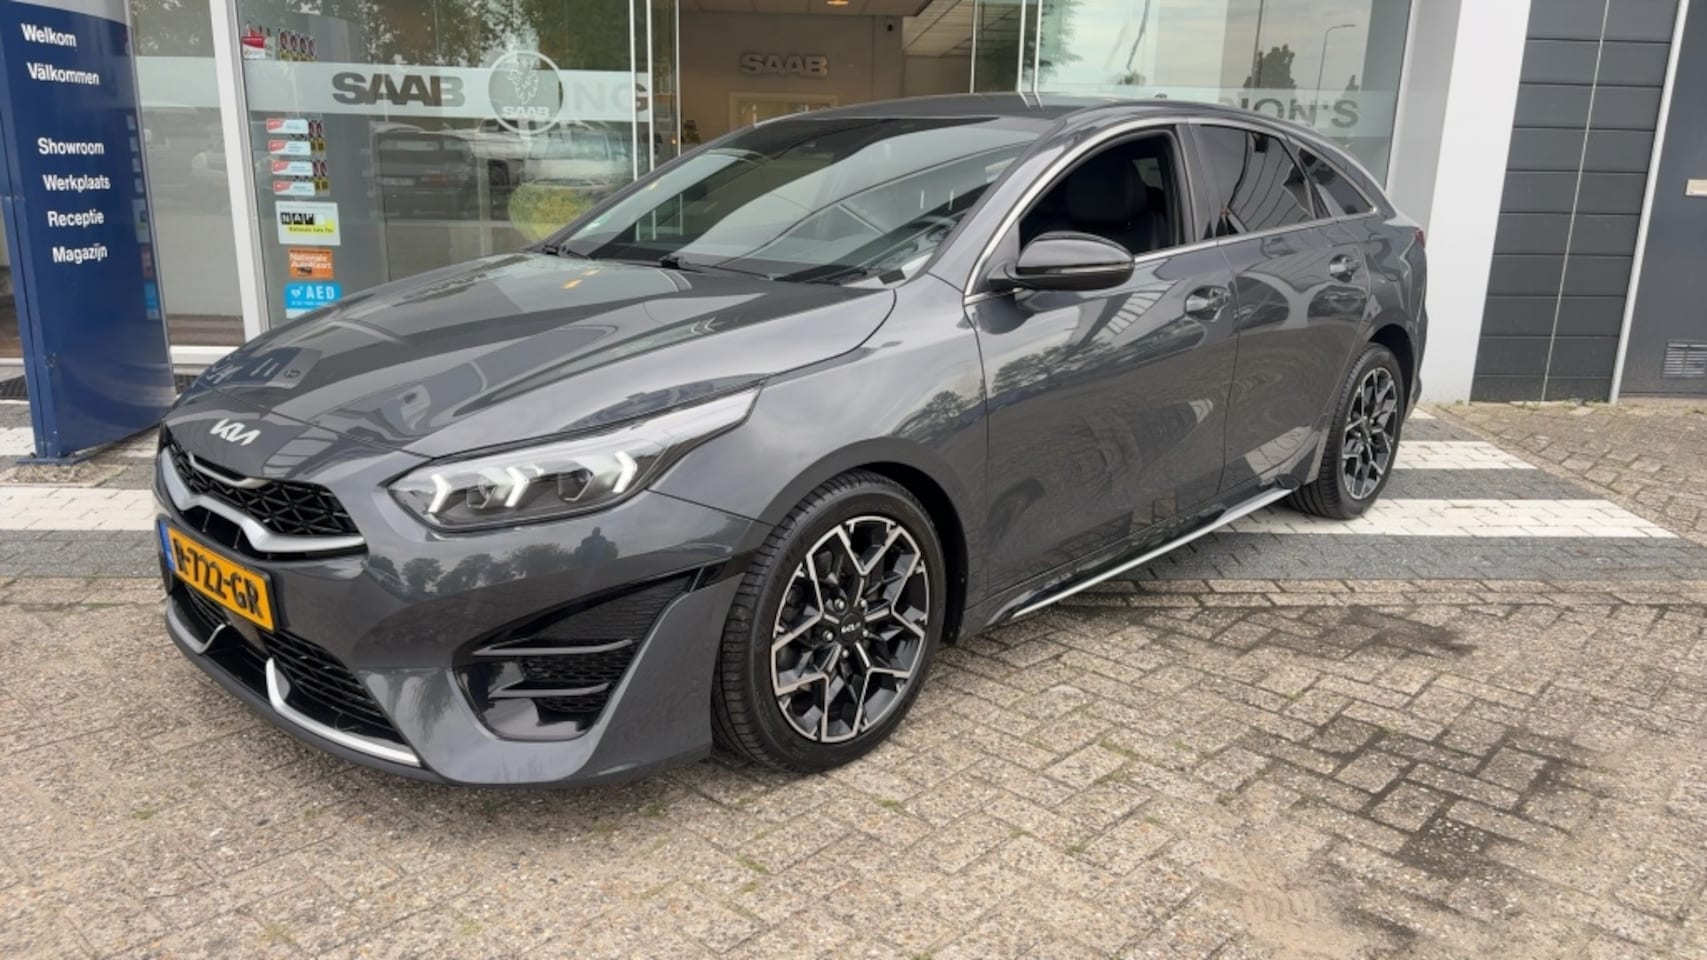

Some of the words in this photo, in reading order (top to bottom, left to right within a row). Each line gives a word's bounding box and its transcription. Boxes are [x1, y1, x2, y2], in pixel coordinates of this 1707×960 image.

[21, 23, 77, 47] Welkom
[27, 62, 100, 86] Välkommen
[741, 54, 828, 76] SAAB
[332, 72, 465, 107] SAAB
[502, 105, 550, 118] SAAB
[37, 137, 105, 155] Showroom
[42, 174, 111, 192] Werkplaats
[47, 209, 104, 228] Receptie
[52, 243, 108, 264] Magazijn
[306, 285, 335, 300] AED
[210, 418, 261, 446] KIA
[173, 537, 264, 619] R-722-GR
